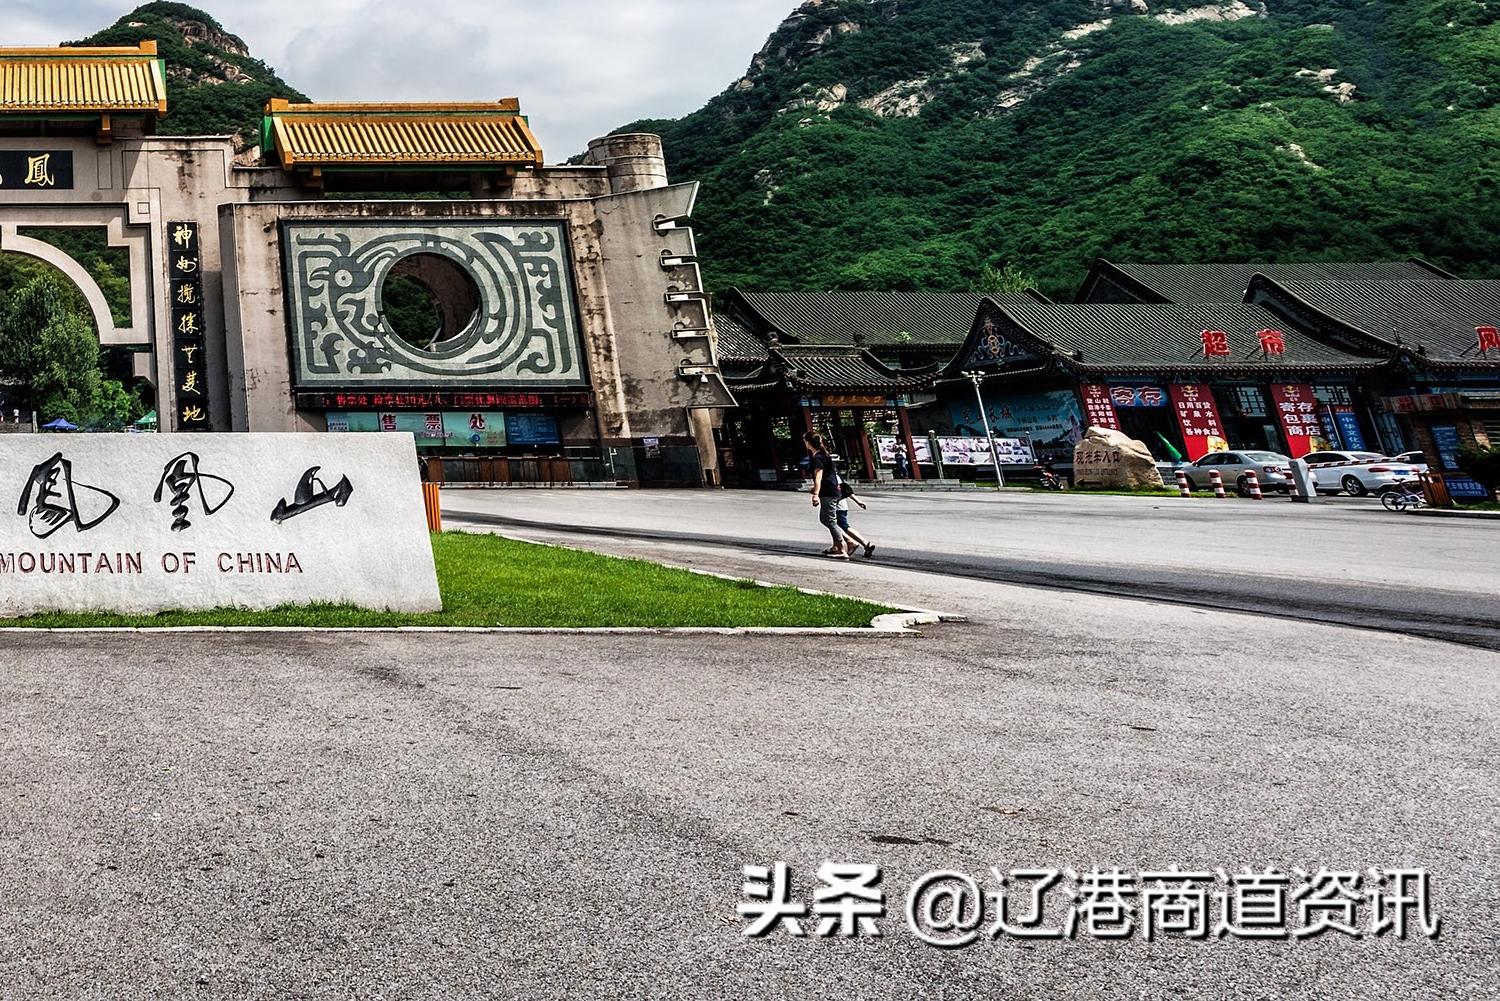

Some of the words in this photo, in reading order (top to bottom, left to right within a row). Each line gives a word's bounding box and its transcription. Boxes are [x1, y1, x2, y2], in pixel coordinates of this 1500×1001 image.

[1200, 329, 1286, 356] 超市
[1110, 386, 1165, 407] 寄存
[1397, 394, 1445, 412] 出口
[1180, 410, 1215, 418] 矿泉水
[1279, 402, 1314, 412] 寄存
[381, 413, 485, 432] 售票处
[1283, 413, 1318, 424] 包裹
[1185, 427, 1220, 436] 各种食品
[1286, 425, 1321, 436] 商店
[161, 551, 197, 575] OF
[216, 551, 304, 575] CHINA
